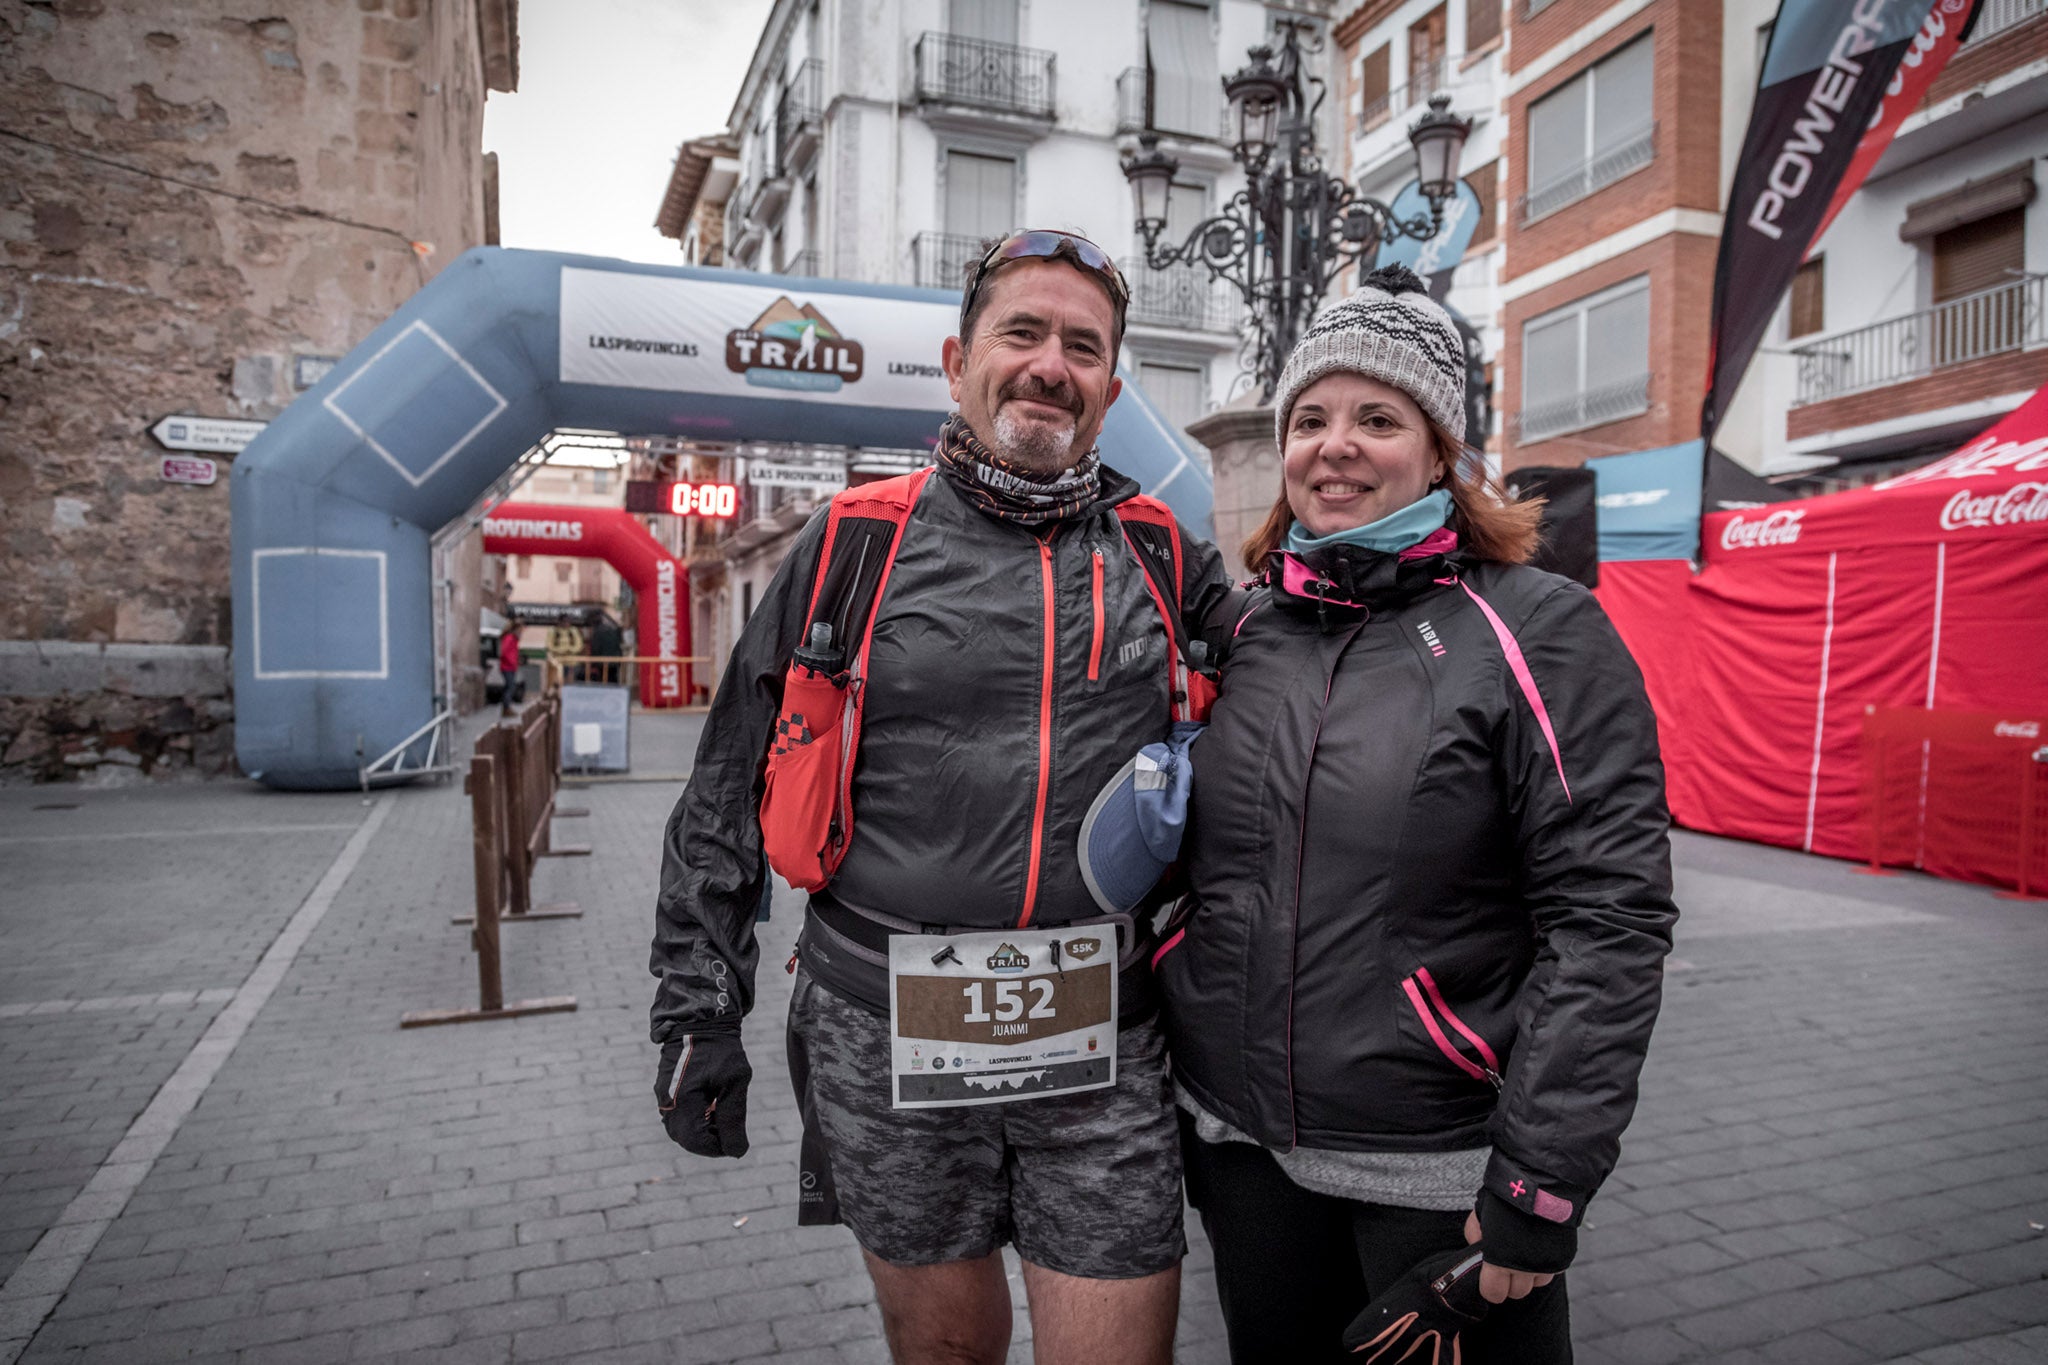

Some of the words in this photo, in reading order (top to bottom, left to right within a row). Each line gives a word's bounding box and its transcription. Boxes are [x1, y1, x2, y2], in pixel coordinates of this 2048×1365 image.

[888, 362, 944, 378] LASPROV
[752, 467, 773, 480] LAS
[776, 470, 843, 483] PROVINCIAS
[672, 482, 736, 517] 0:00
[1072, 942, 1094, 954] 55K
[963, 978, 1056, 1023] 152
[992, 1023, 1028, 1037] JUANMI
[988, 1055, 1032, 1065] LASPROVINCIAS
